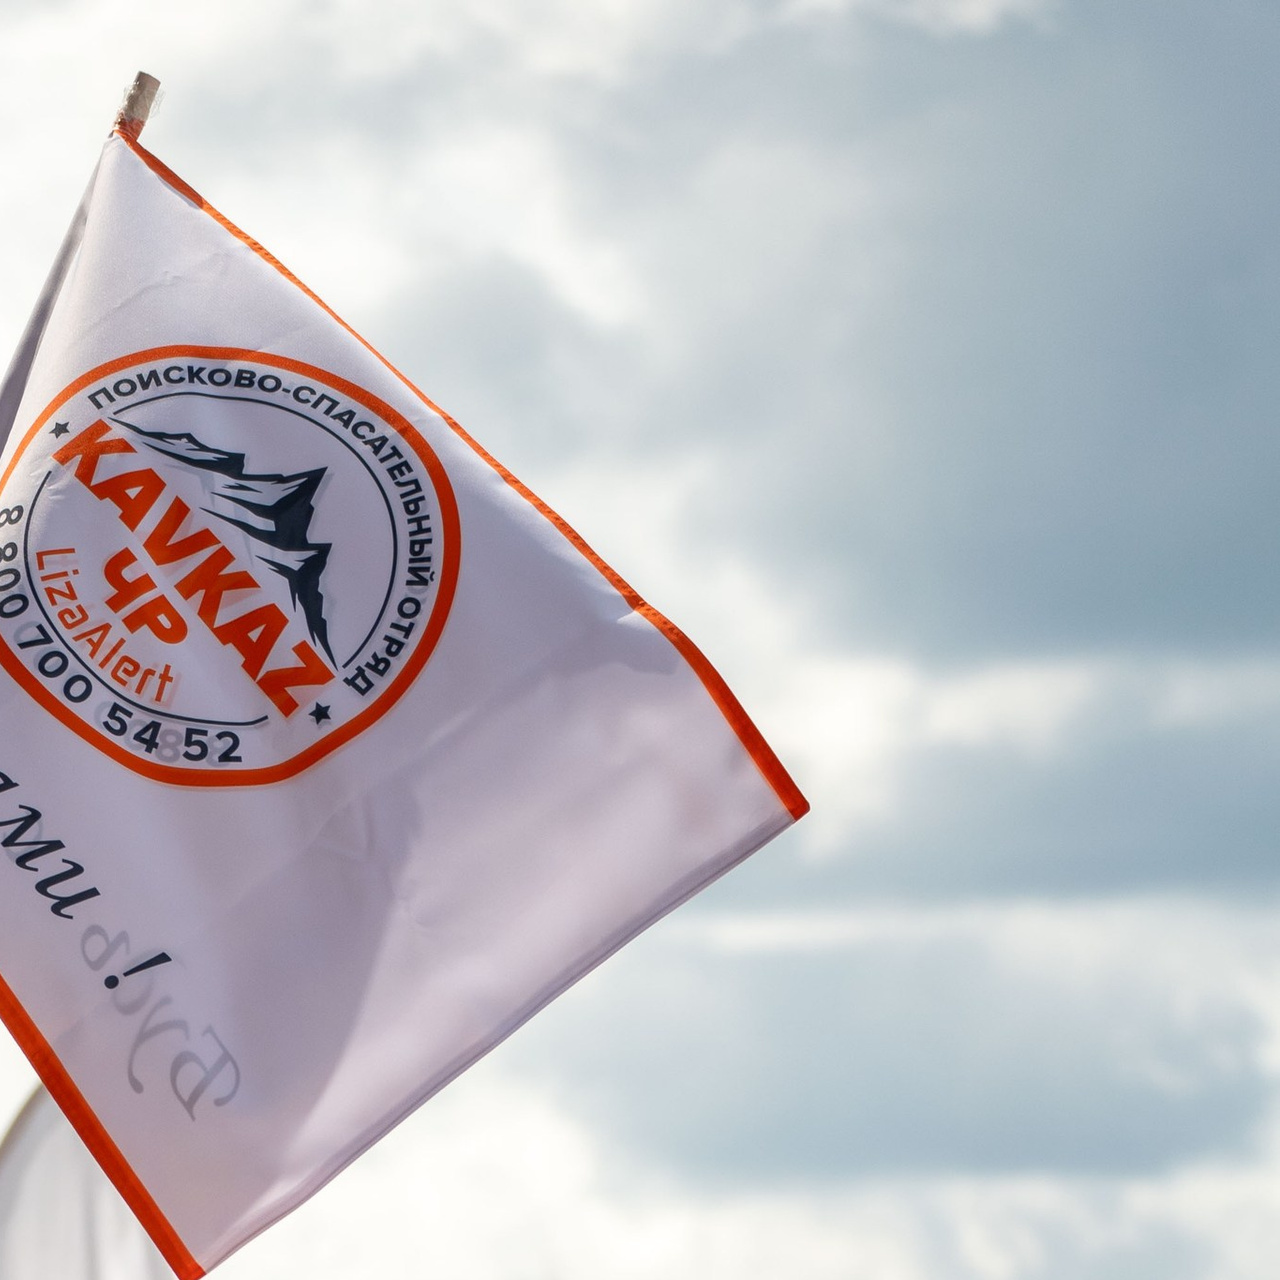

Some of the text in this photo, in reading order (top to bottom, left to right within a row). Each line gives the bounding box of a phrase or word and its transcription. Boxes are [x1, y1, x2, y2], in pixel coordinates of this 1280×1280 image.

[51, 418, 336, 719] KAVKAZ
[87, 365, 435, 697] ПОИСКОВО-СПАСАТЕЛЬНЫЙ ОТРЯД
[103, 547, 188, 644] ЧР
[17, 623, 93, 704] 700
[102, 702, 162, 754] 54
[182, 728, 243, 763] 52
[35, 548, 173, 702] LizaAlert
